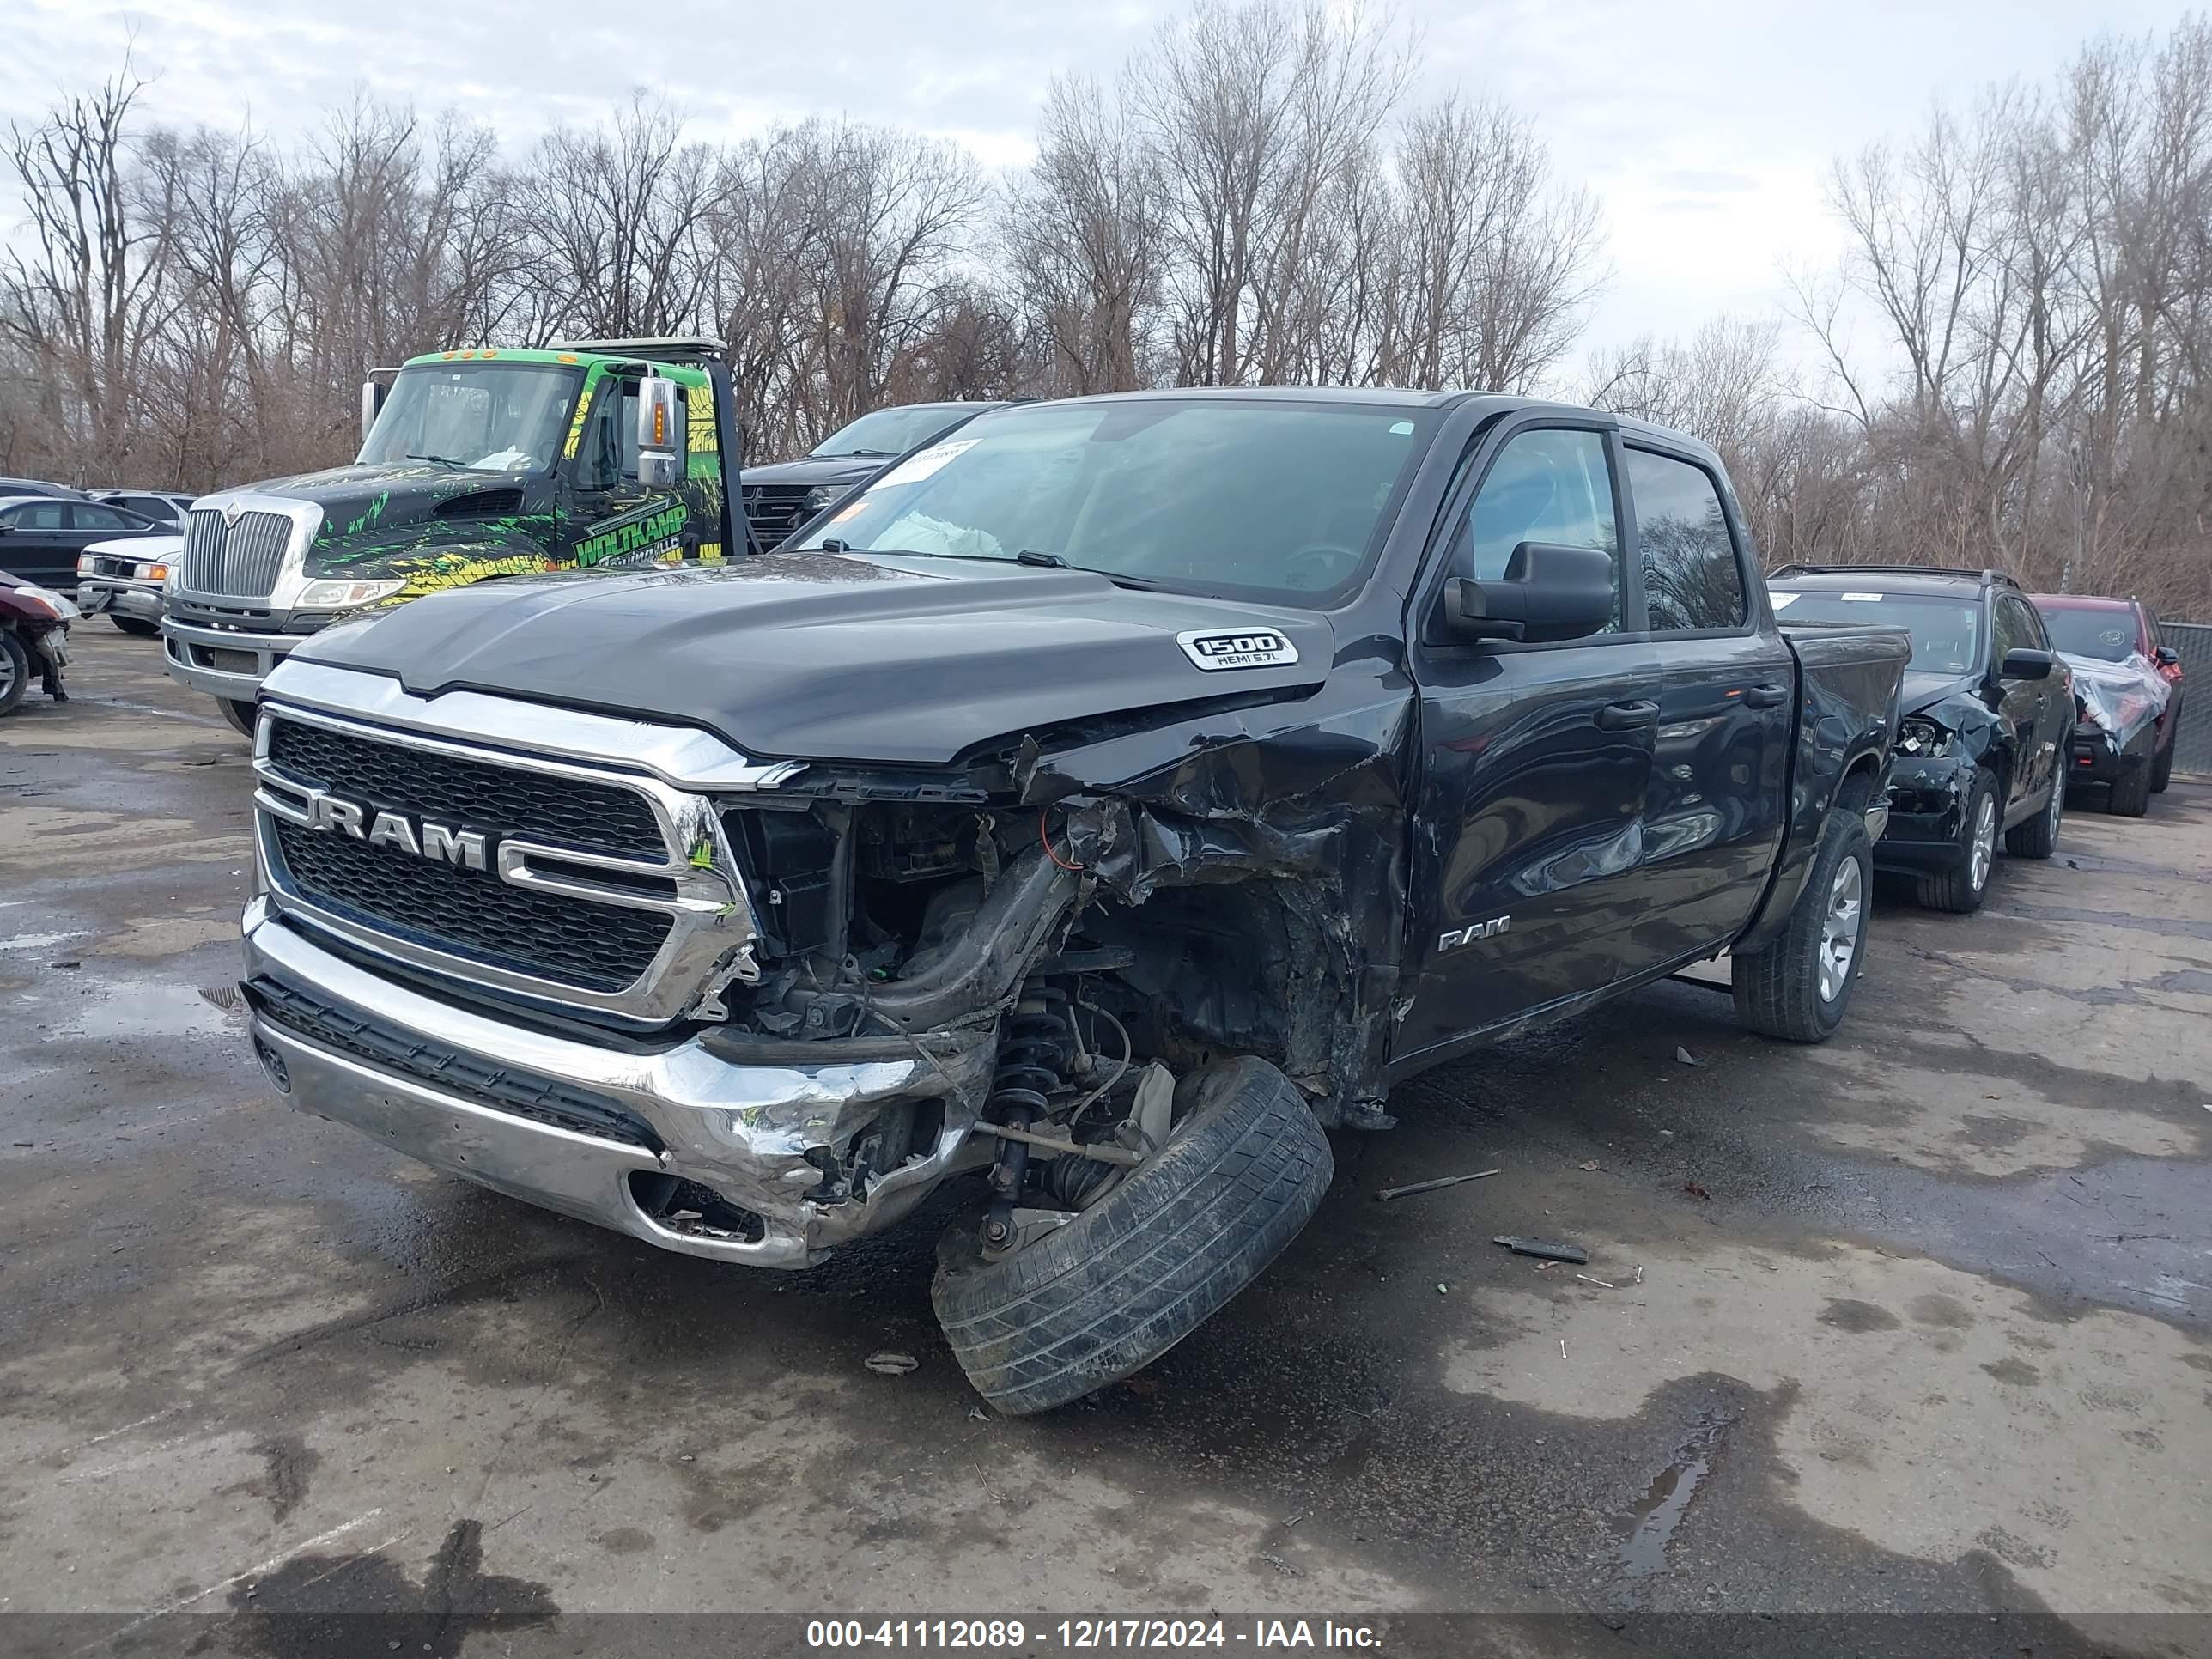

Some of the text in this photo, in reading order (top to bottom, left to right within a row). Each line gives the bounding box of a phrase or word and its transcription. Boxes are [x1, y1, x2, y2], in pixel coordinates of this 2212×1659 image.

[575, 504, 688, 568] WOLTKAMP
[659, 537, 679, 553] LLC
[1195, 635, 1279, 655] 1500
[1217, 653, 1281, 665] HEMI 5.7L
[319, 793, 487, 872] RAM
[1437, 915, 1511, 952] RAM
